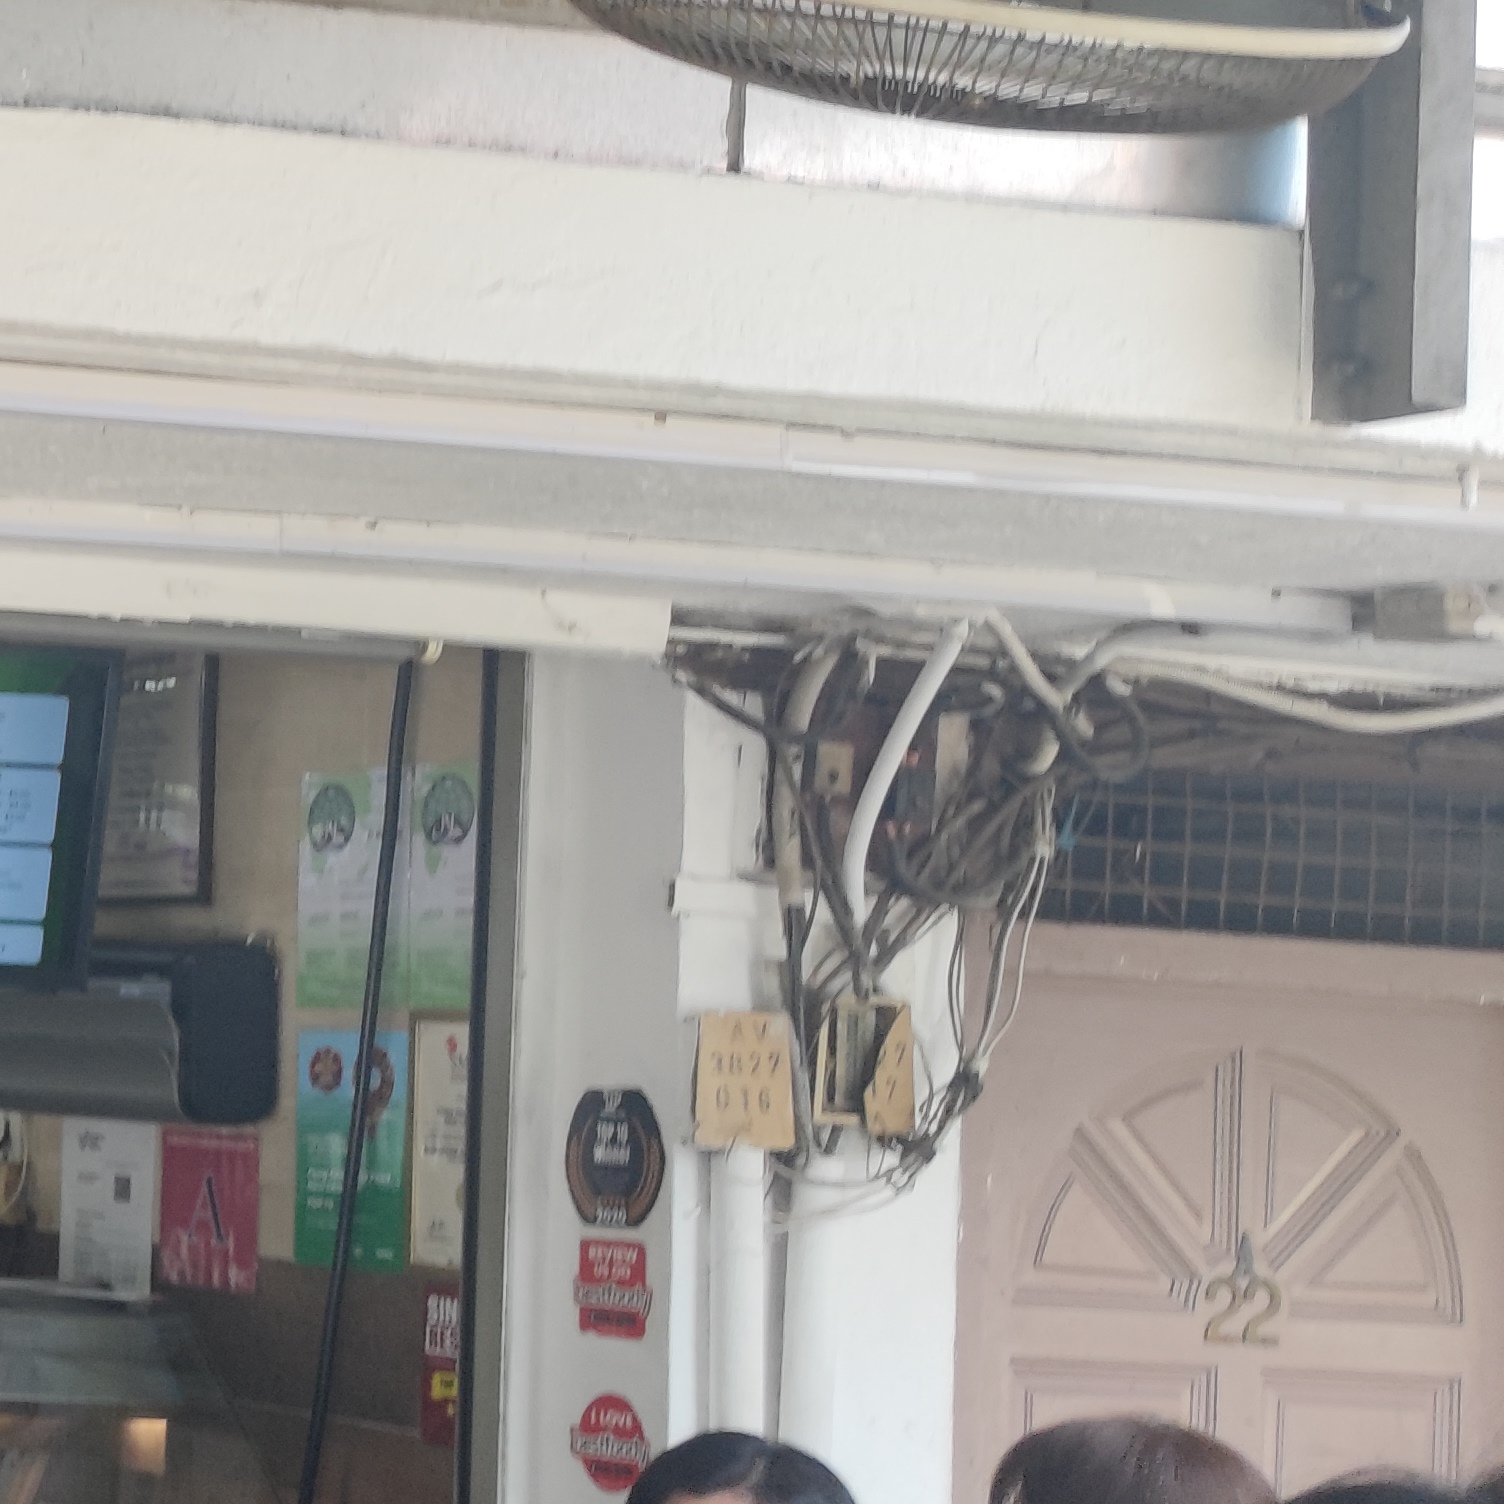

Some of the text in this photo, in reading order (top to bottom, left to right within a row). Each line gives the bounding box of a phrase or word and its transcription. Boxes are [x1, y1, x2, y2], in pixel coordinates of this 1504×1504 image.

[588, 1246, 638, 1265] REVIEW
[1203, 1275, 1282, 1345] 22
[599, 1407, 634, 1428] LOVE
